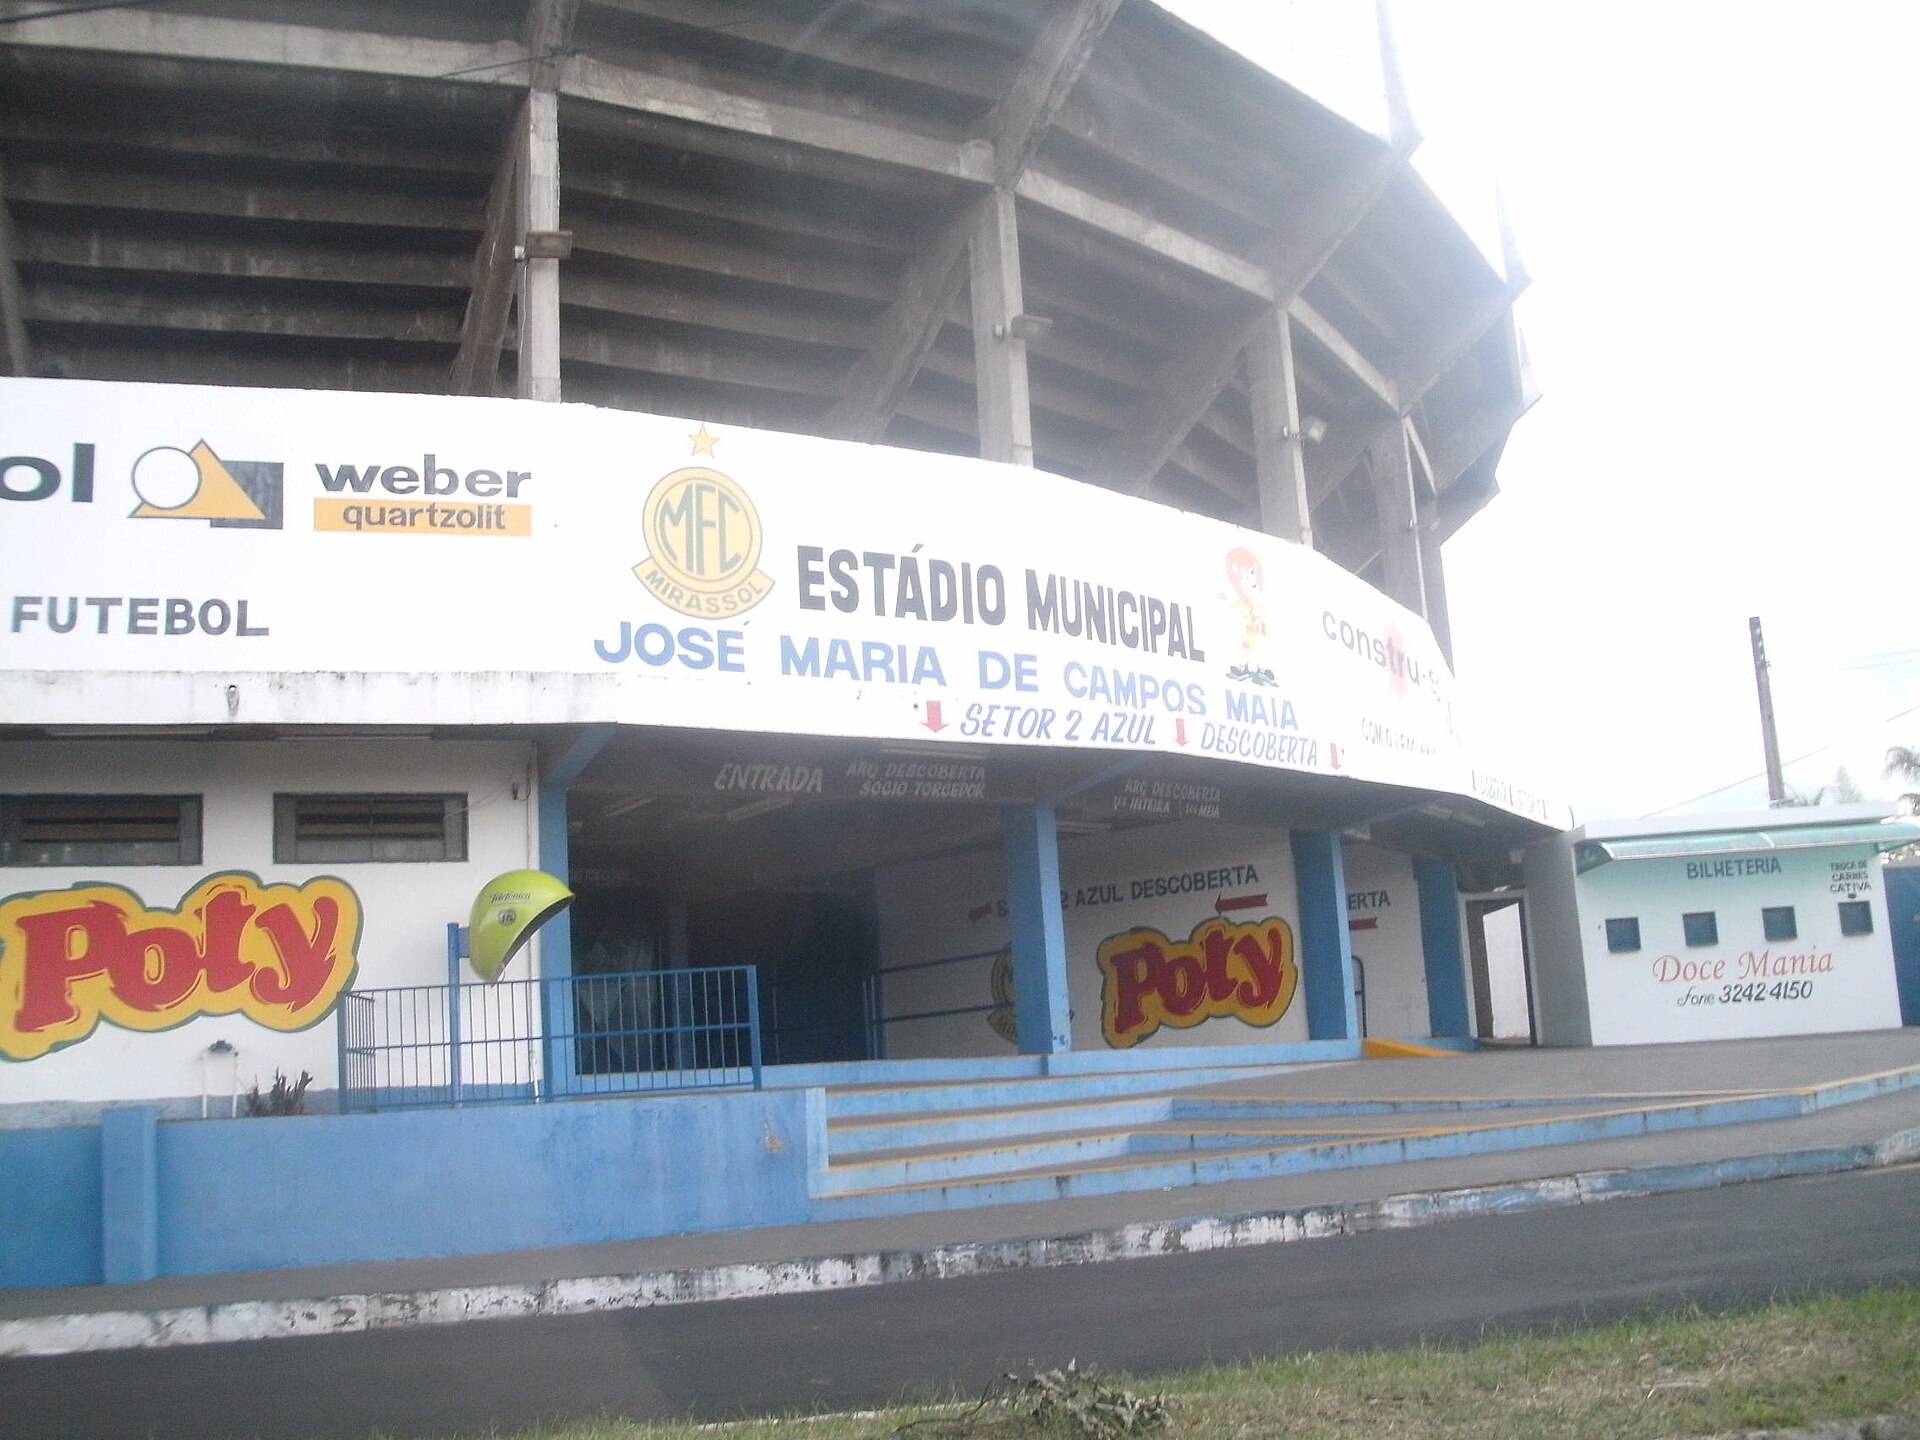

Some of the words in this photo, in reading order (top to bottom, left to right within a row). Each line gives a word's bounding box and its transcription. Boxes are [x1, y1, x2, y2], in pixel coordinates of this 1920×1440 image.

[315, 454, 531, 498] weber
[342, 502, 507, 531] quartzolit
[659, 483, 743, 576] MFC
[645, 569, 763, 614] MIRASSOL
[797, 543, 1007, 627] ESTÁDIO
[1025, 568, 1206, 663] MUNICIPAL
[10, 596, 270, 637] FUTEBOL
[594, 620, 750, 672] JOSÉ
[780, 635, 948, 687] MARIA
[978, 650, 1039, 693] DE
[1063, 661, 1207, 716] CAMPOS
[1225, 689, 1298, 731] MAIA
[960, 702, 1057, 740] SETOR
[1065, 709, 1083, 742] 2
[1091, 711, 1155, 745] AZUL
[1200, 721, 1318, 767] DESCOBERTA
[714, 764, 823, 793] ENTRADA
[885, 762, 986, 780] DESCOBERTA
[914, 781, 986, 799] TORCEDOR
[1076, 881, 1124, 907] AZUL
[1131, 864, 1260, 900] DESCOBERTA
[1686, 856, 1782, 880] BILHETERIA
[1347, 889, 1391, 911] ERTA
[15, 887, 340, 1033] Poty
[1110, 925, 1285, 1034] Poty
[1652, 954, 1727, 983] Doce
[1738, 945, 1834, 980] Mania
